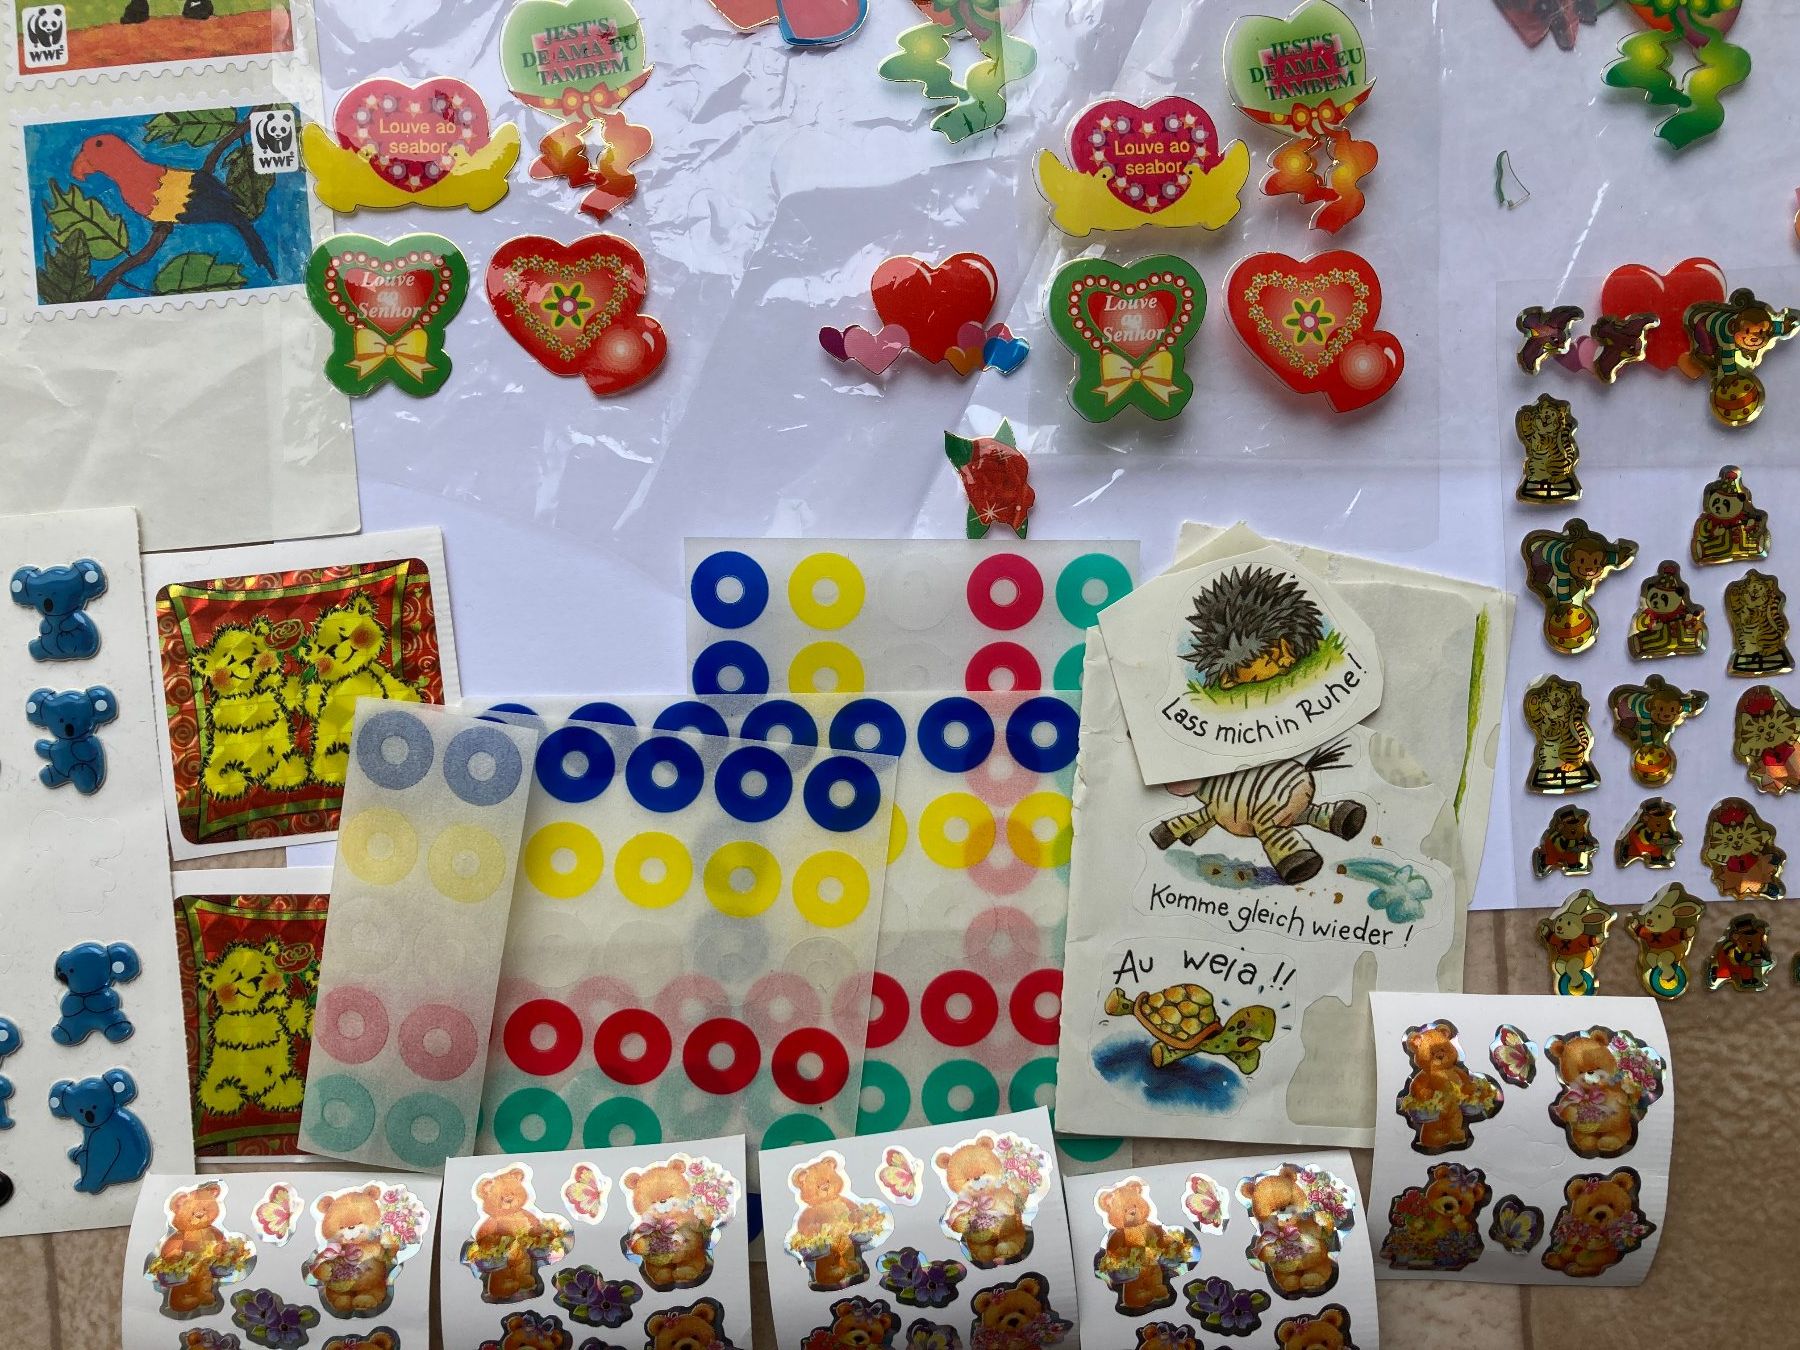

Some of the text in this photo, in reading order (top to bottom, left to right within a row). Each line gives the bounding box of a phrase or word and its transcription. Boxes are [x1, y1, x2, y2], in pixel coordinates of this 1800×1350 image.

[29, 48, 64, 63] WWF
[521, 34, 638, 68] DE AMA EU
[536, 57, 631, 86] TAMBEM
[1248, 47, 1362, 84] DE AMA EU
[1265, 71, 1357, 101] TAMBEM
[379, 118, 456, 134] Louve ao
[389, 139, 448, 154] seabor
[1114, 140, 1190, 156] Louve ao
[259, 155, 294, 168] WWF
[1125, 159, 1183, 175] seabor
[360, 271, 416, 288] Louve
[357, 302, 422, 319] Senhor
[1104, 295, 1158, 311] Louve
[1103, 326, 1166, 343] Senhor
[1161, 652, 1367, 745] Lass mich in Ruhe!
[1149, 883, 1229, 917] Komme
[1228, 898, 1305, 937] gleich
[1112, 949, 1154, 985] Au
